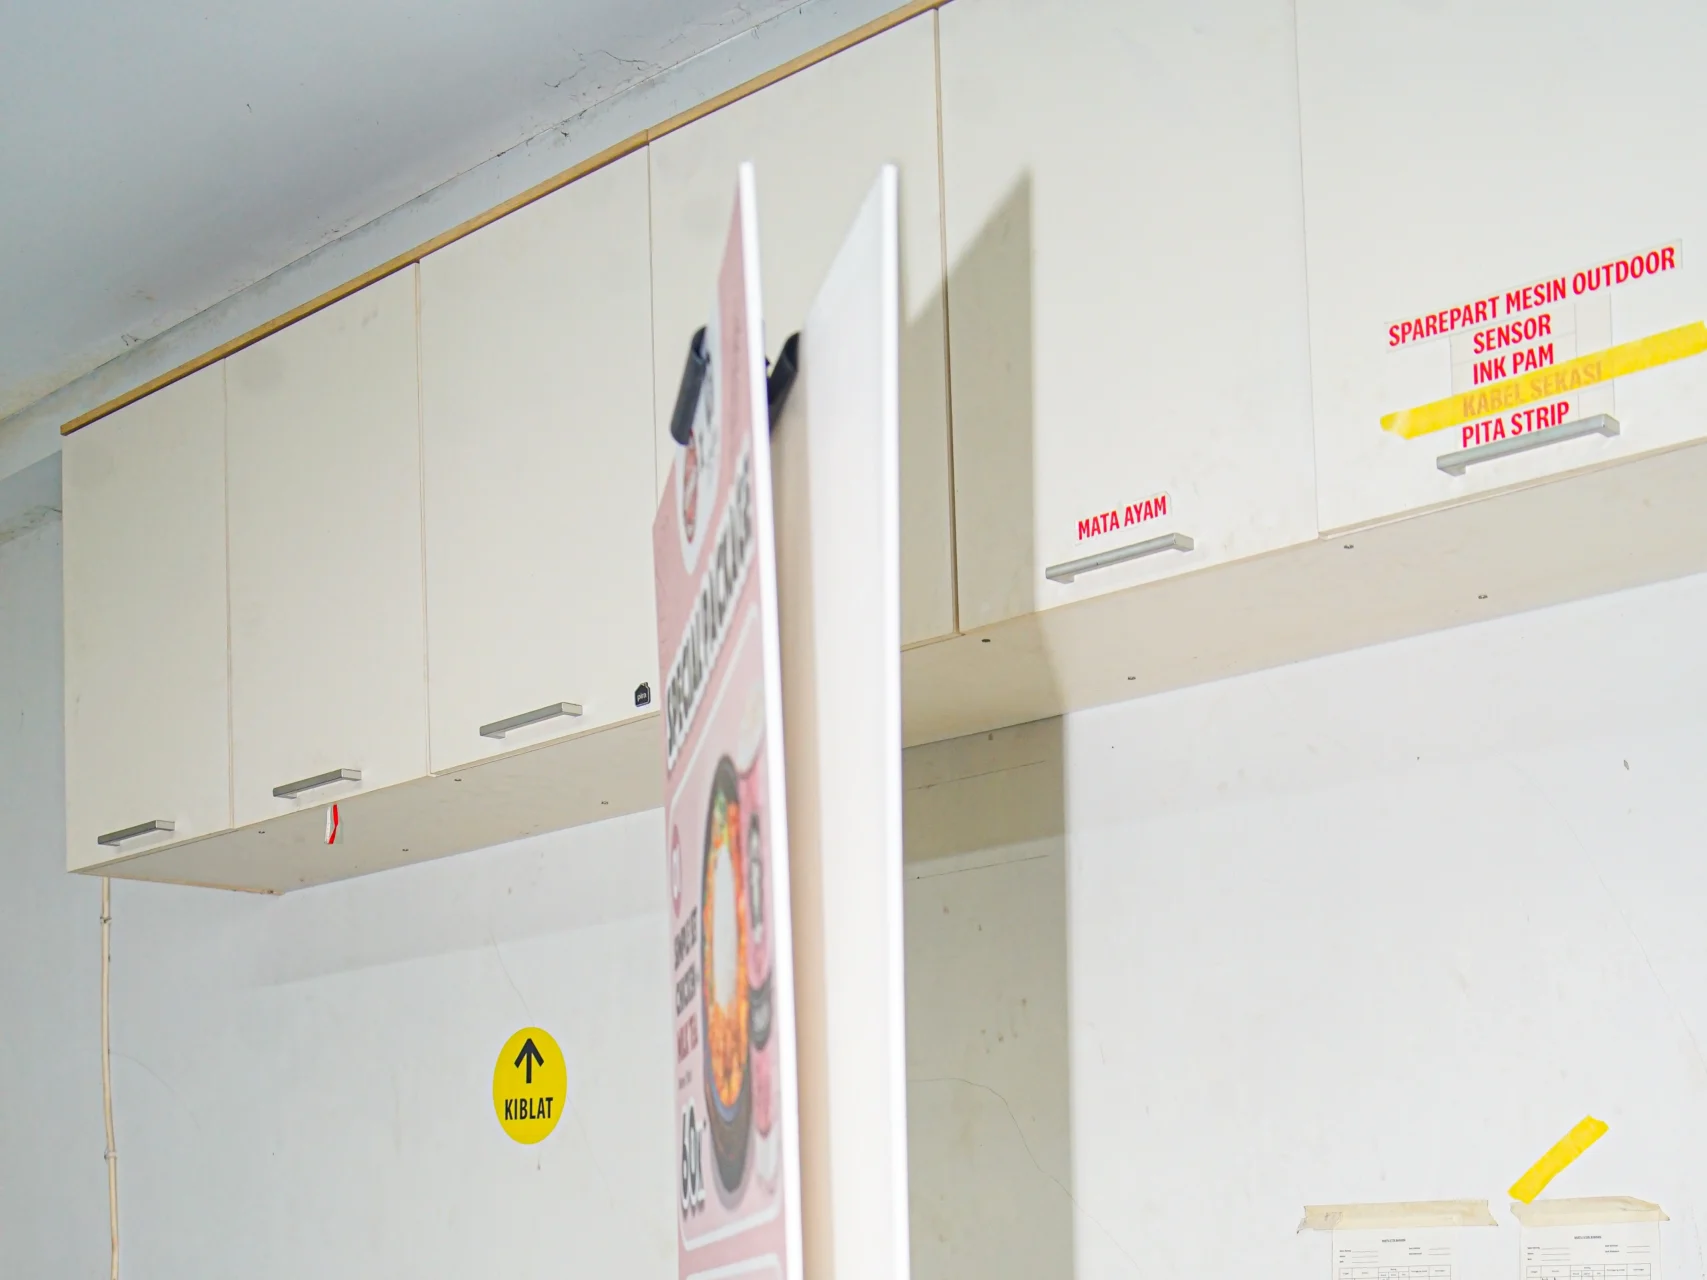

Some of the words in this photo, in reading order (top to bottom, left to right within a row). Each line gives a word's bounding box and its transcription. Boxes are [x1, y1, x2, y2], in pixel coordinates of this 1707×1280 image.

[1388, 295, 1500, 348] SPAREPART
[1505, 276, 1567, 315] MESIN
[1571, 246, 1676, 296] OUTDOOR
[1472, 312, 1552, 355] SENSOR
[1472, 355, 1507, 386] INK
[1511, 342, 1555, 376] PAM
[1463, 382, 1524, 418] KABEL
[1461, 417, 1507, 449] PITA
[1510, 400, 1570, 437] STRIP
[1077, 510, 1121, 541] MATA
[1123, 495, 1168, 527] AYAM
[504, 1097, 554, 1121] KIBLAT
